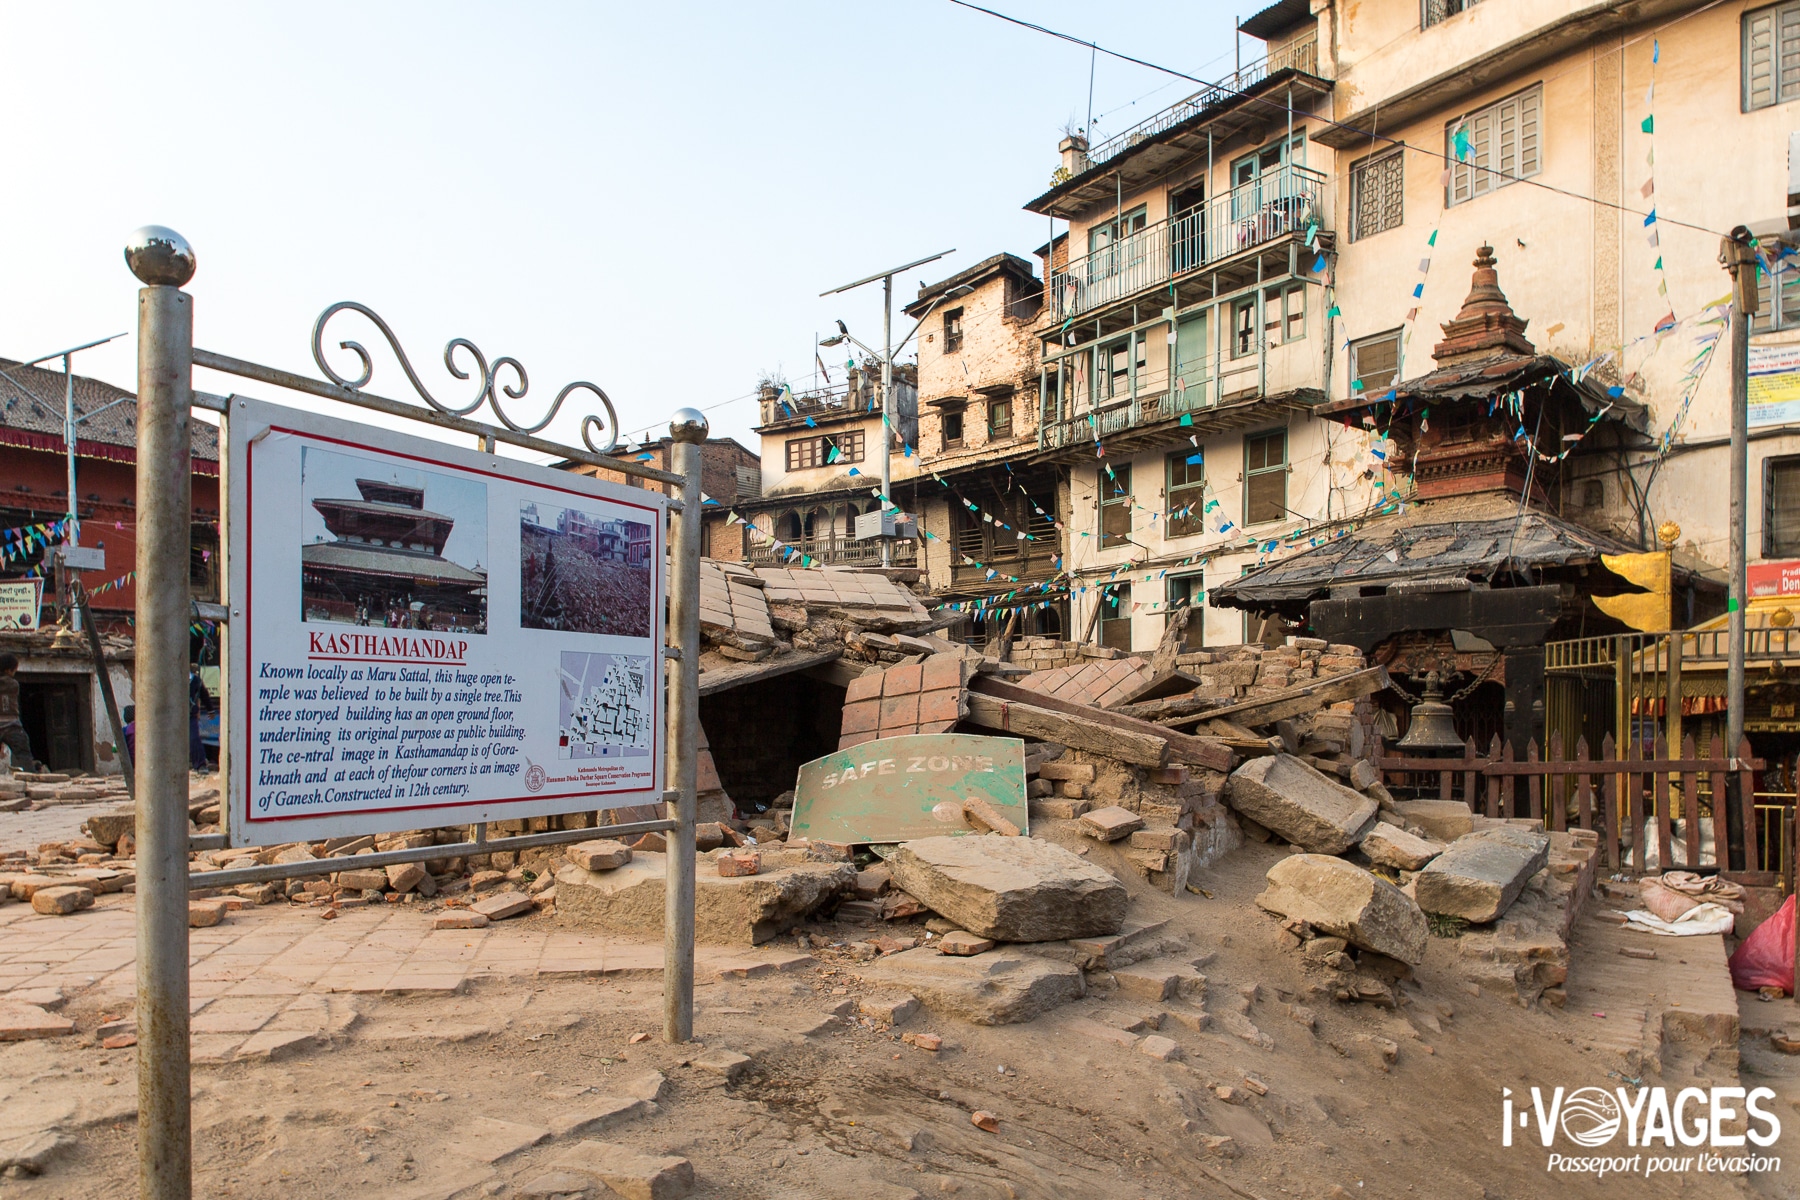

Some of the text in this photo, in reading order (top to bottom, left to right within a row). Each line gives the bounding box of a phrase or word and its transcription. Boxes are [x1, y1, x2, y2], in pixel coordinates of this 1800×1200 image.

[308, 632, 468, 660] KASTHAMANDAP
[259, 662, 516, 687] Known locally as Maru Sattal, this huge open te-
[259, 684, 290, 704] mple
[294, 689, 318, 700] was
[321, 685, 370, 700] believed
[375, 688, 386, 701] to
[389, 686, 402, 701] be
[404, 686, 429, 701] built
[431, 687, 443, 705] by
[445, 693, 452, 701] a
[453, 688, 481, 705] single
[259, 705, 514, 725] three storyed building has an open ground floor,
[259, 725, 526, 745] underlining its original purpose as public building.
[260, 743, 519, 764] The ce-ntral image in Kasthamandap is of Gora-
[259, 769, 301, 786] khnath
[304, 767, 328, 783] and
[334, 769, 346, 782] at
[349, 765, 375, 781] each
[378, 764, 391, 783] of
[430, 765, 467, 777] corners
[470, 762, 478, 775] is
[480, 766, 491, 774] an
[494, 761, 520, 776] image
[821, 755, 995, 790] SAFE ZONE
[259, 791, 275, 811] of
[394, 785, 405, 798] in
[408, 782, 430, 797] 12th
[432, 783, 470, 797] century.
